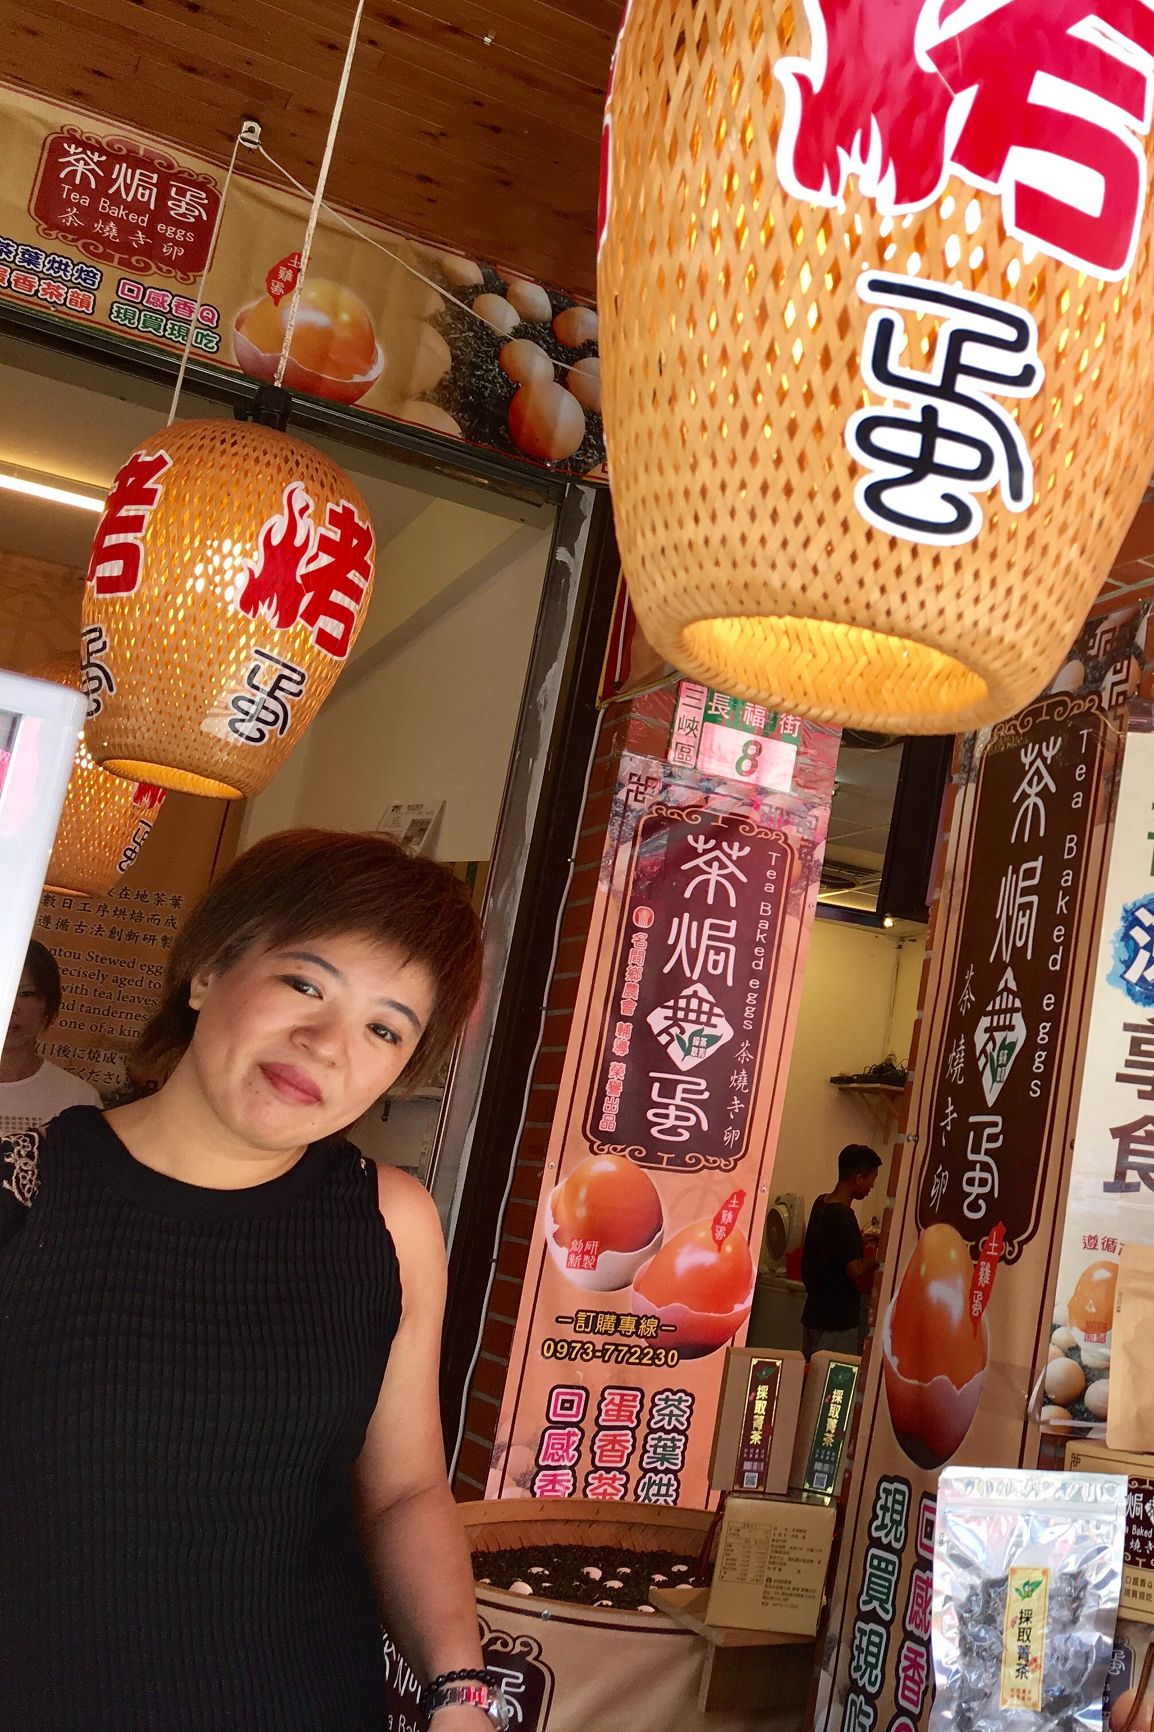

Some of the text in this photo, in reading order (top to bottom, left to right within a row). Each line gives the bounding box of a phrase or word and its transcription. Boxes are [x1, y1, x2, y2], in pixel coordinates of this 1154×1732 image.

[58, 143, 208, 223] 茶焗蛋
[61, 184, 194, 243] Tea Baked eggs
[117, 279, 219, 327] 口感香Q
[111, 304, 221, 353] 現買現吃
[227, 481, 375, 746] 烤蛋
[672, 685, 704, 766] 三峽區
[708, 692, 801, 738] 長福街
[735, 740, 762, 777] 8
[1029, 729, 1093, 1097] Tea Baked eggs
[50, 947, 164, 977] ntou Stewed egg
[743, 852, 781, 1030] Tea Baked eggs
[93, 987, 113, 1000] tea
[112, 975, 144, 989] aged
[148, 979, 162, 990] to
[60, 1019, 86, 1031] one
[90, 1021, 106, 1034] of
[119, 1024, 141, 1039] kin
[599, 932, 649, 1132] 名間鄉農會 輔導 榮譽出品
[542, 1341, 679, 1367] 0973-772230
[1132, 1524, 1153, 1538] Baked
